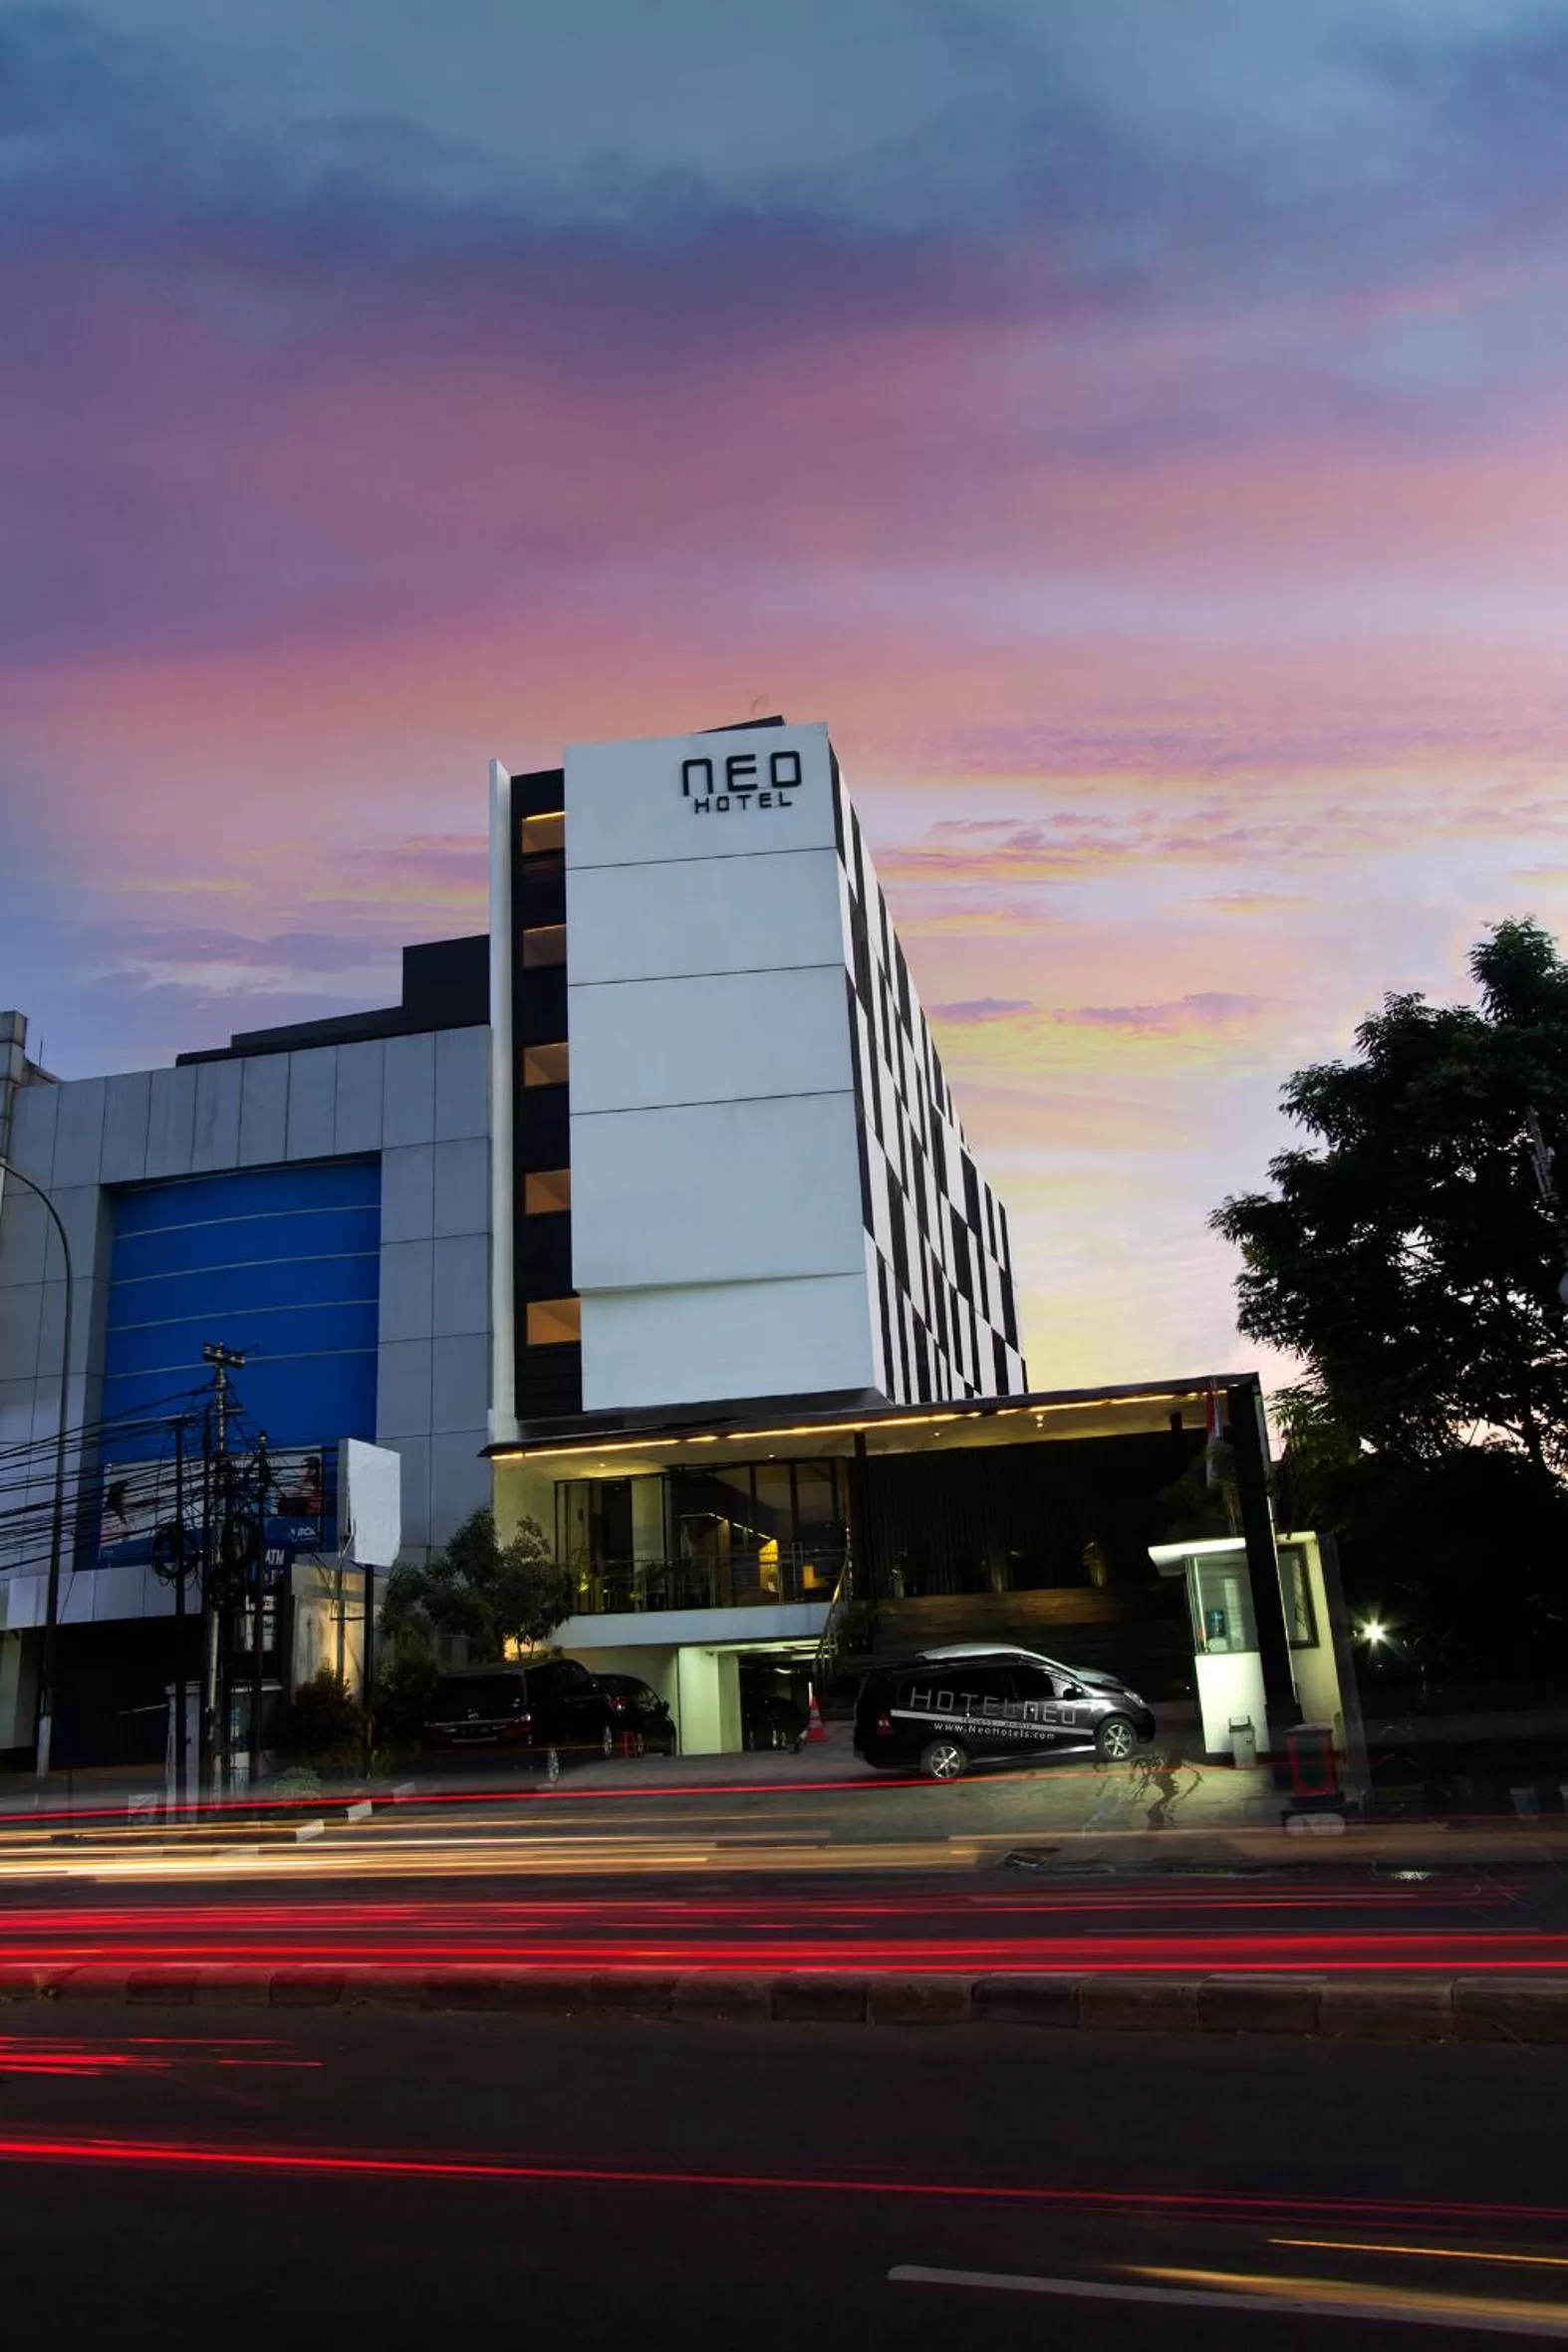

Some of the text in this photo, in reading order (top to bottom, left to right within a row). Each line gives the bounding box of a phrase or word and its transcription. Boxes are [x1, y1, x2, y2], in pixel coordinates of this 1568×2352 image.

[694, 791, 793, 814] HOTEL
[265, 1547, 286, 1566] ATM
[910, 1686, 1017, 1718] HOTEL
